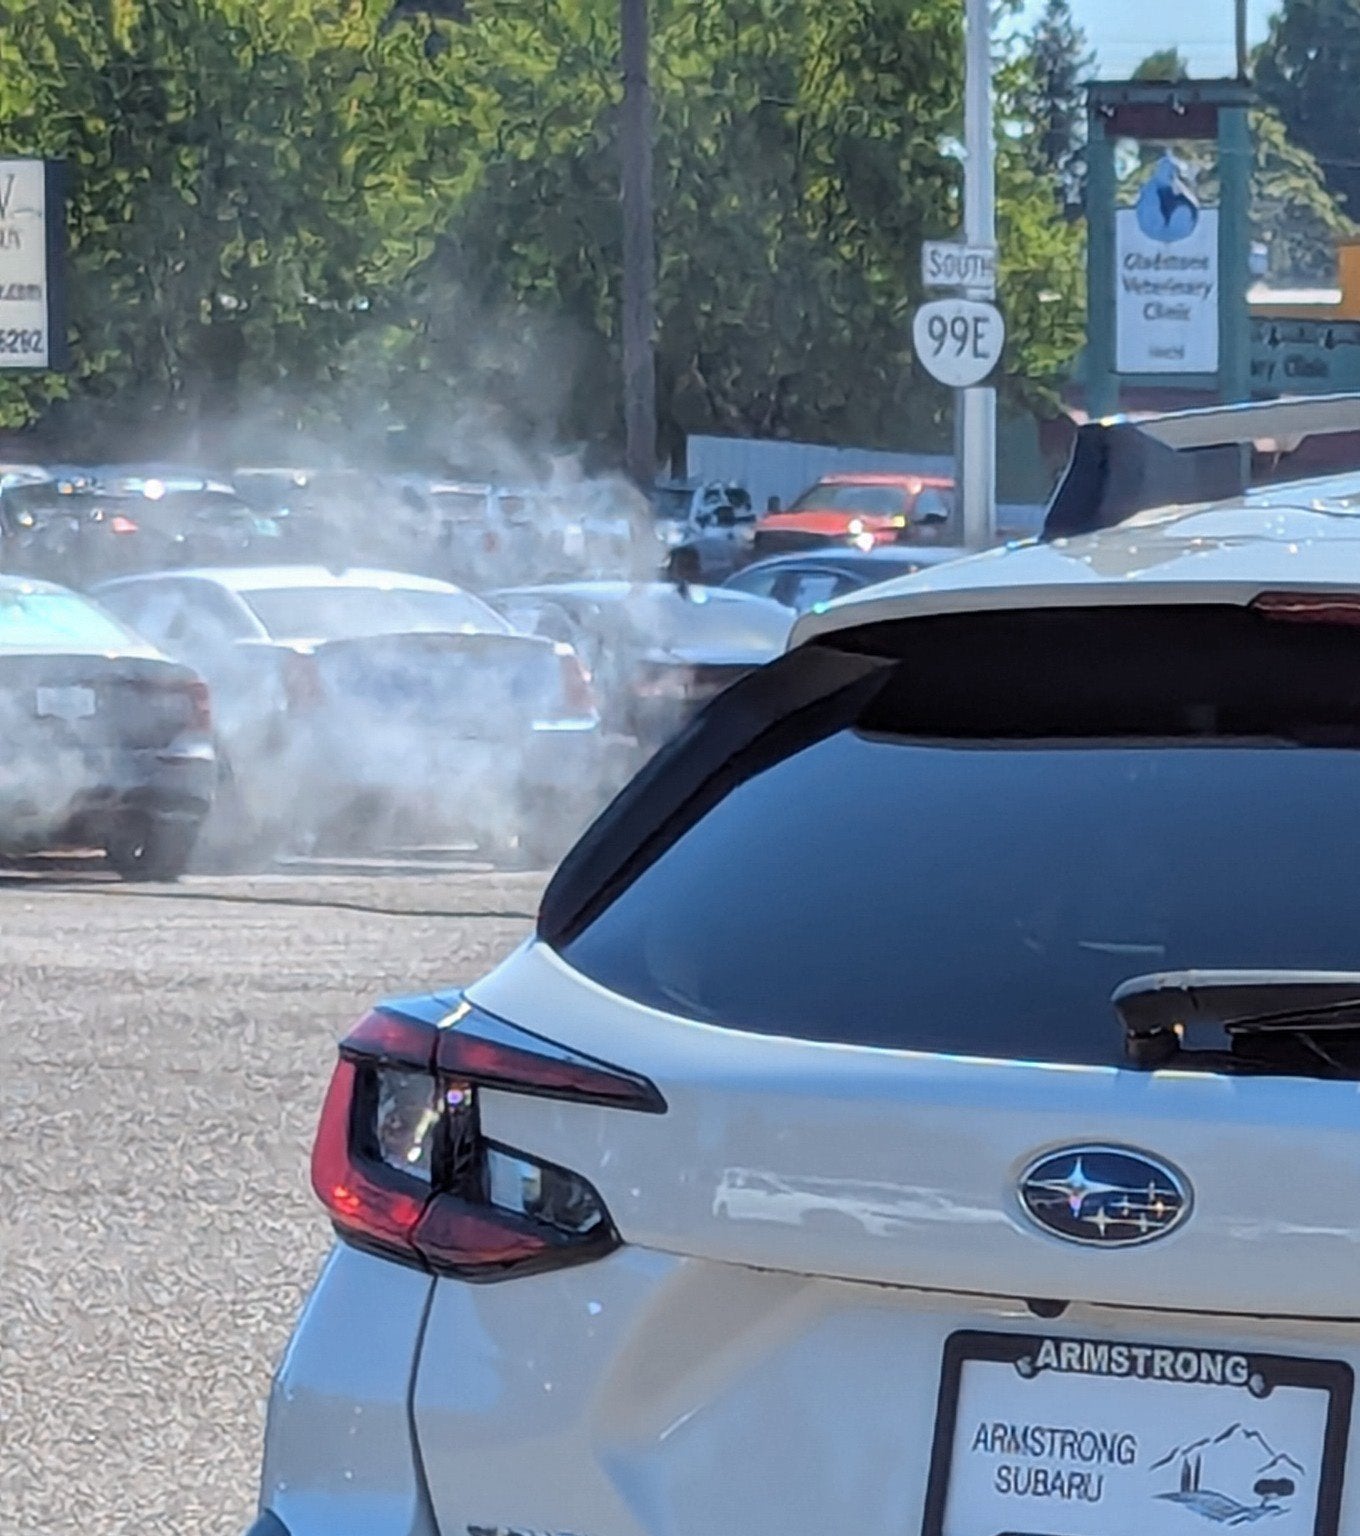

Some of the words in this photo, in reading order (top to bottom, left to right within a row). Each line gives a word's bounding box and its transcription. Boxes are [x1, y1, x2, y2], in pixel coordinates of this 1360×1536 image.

[927, 314, 991, 359] 99E
[1035, 1339, 1249, 1385] ARMSTRONG
[972, 1422, 1138, 1465] ARMSTRONG
[994, 1464, 1104, 1503] SUBARU
